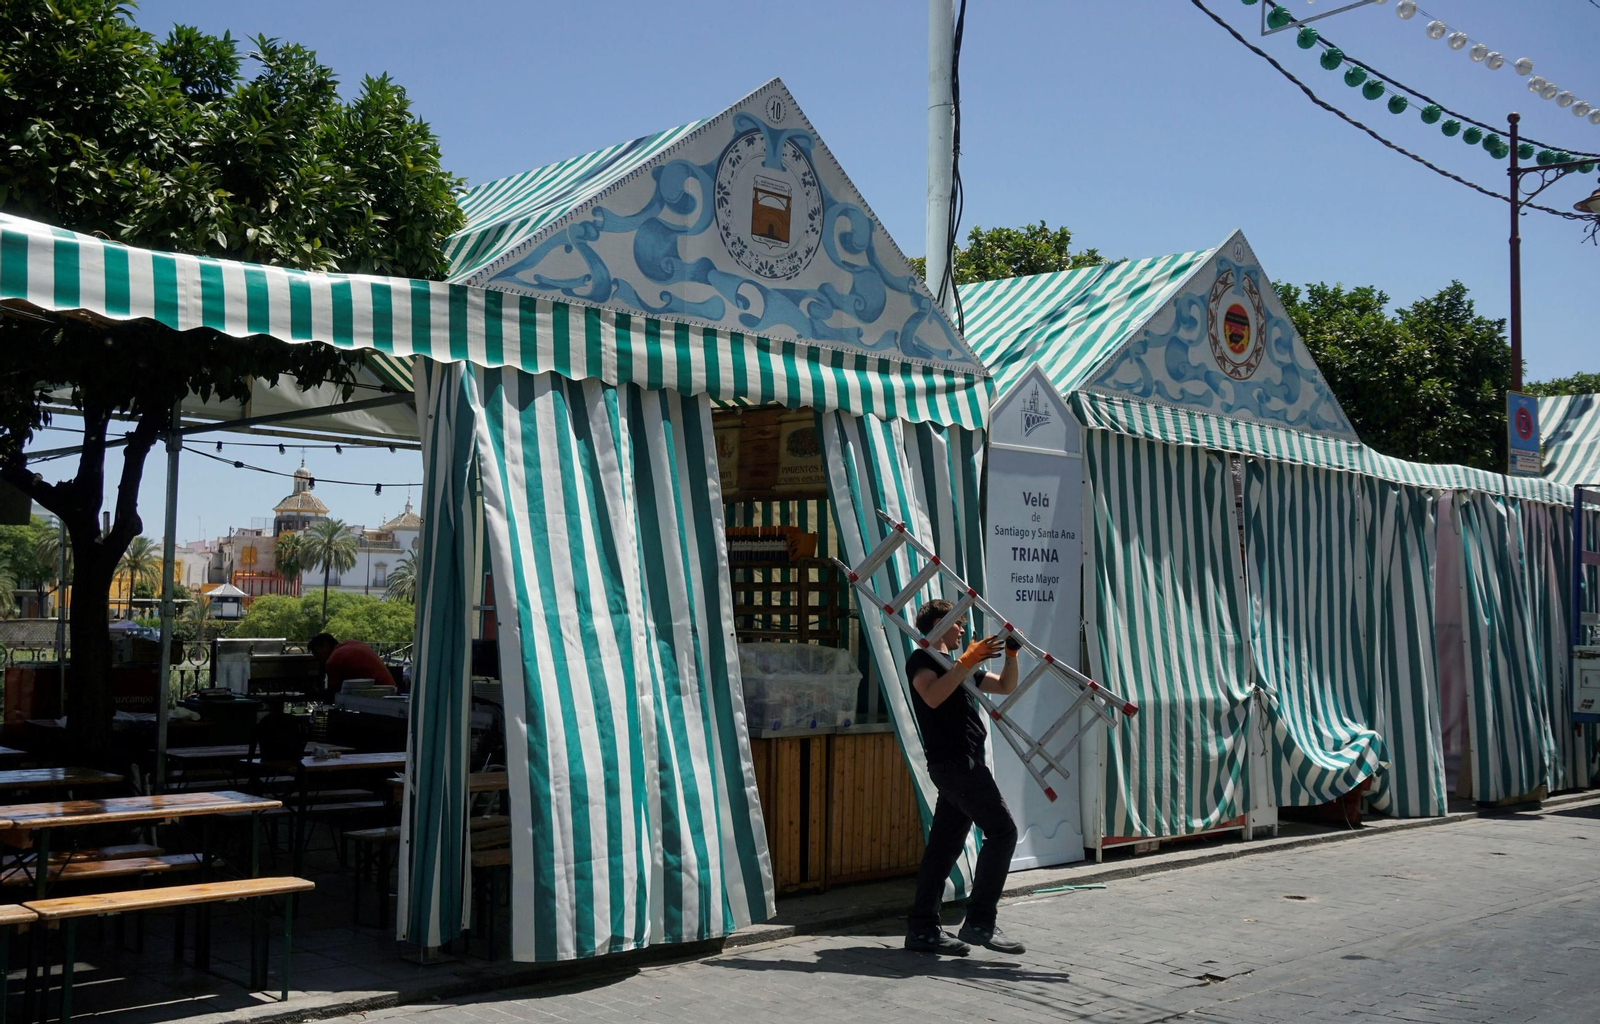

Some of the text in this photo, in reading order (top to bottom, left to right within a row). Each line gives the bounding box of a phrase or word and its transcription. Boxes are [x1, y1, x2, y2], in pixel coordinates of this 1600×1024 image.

[771, 101, 781, 120] 10
[1022, 491, 1050, 508] Velá
[1031, 512, 1041, 523] de
[994, 525, 1076, 540] Santiago y Santa Ana
[1011, 547, 1060, 563] TRIANA
[1010, 572, 1060, 586] Fiesta Mayor
[1015, 589, 1055, 602] SEVILLA
